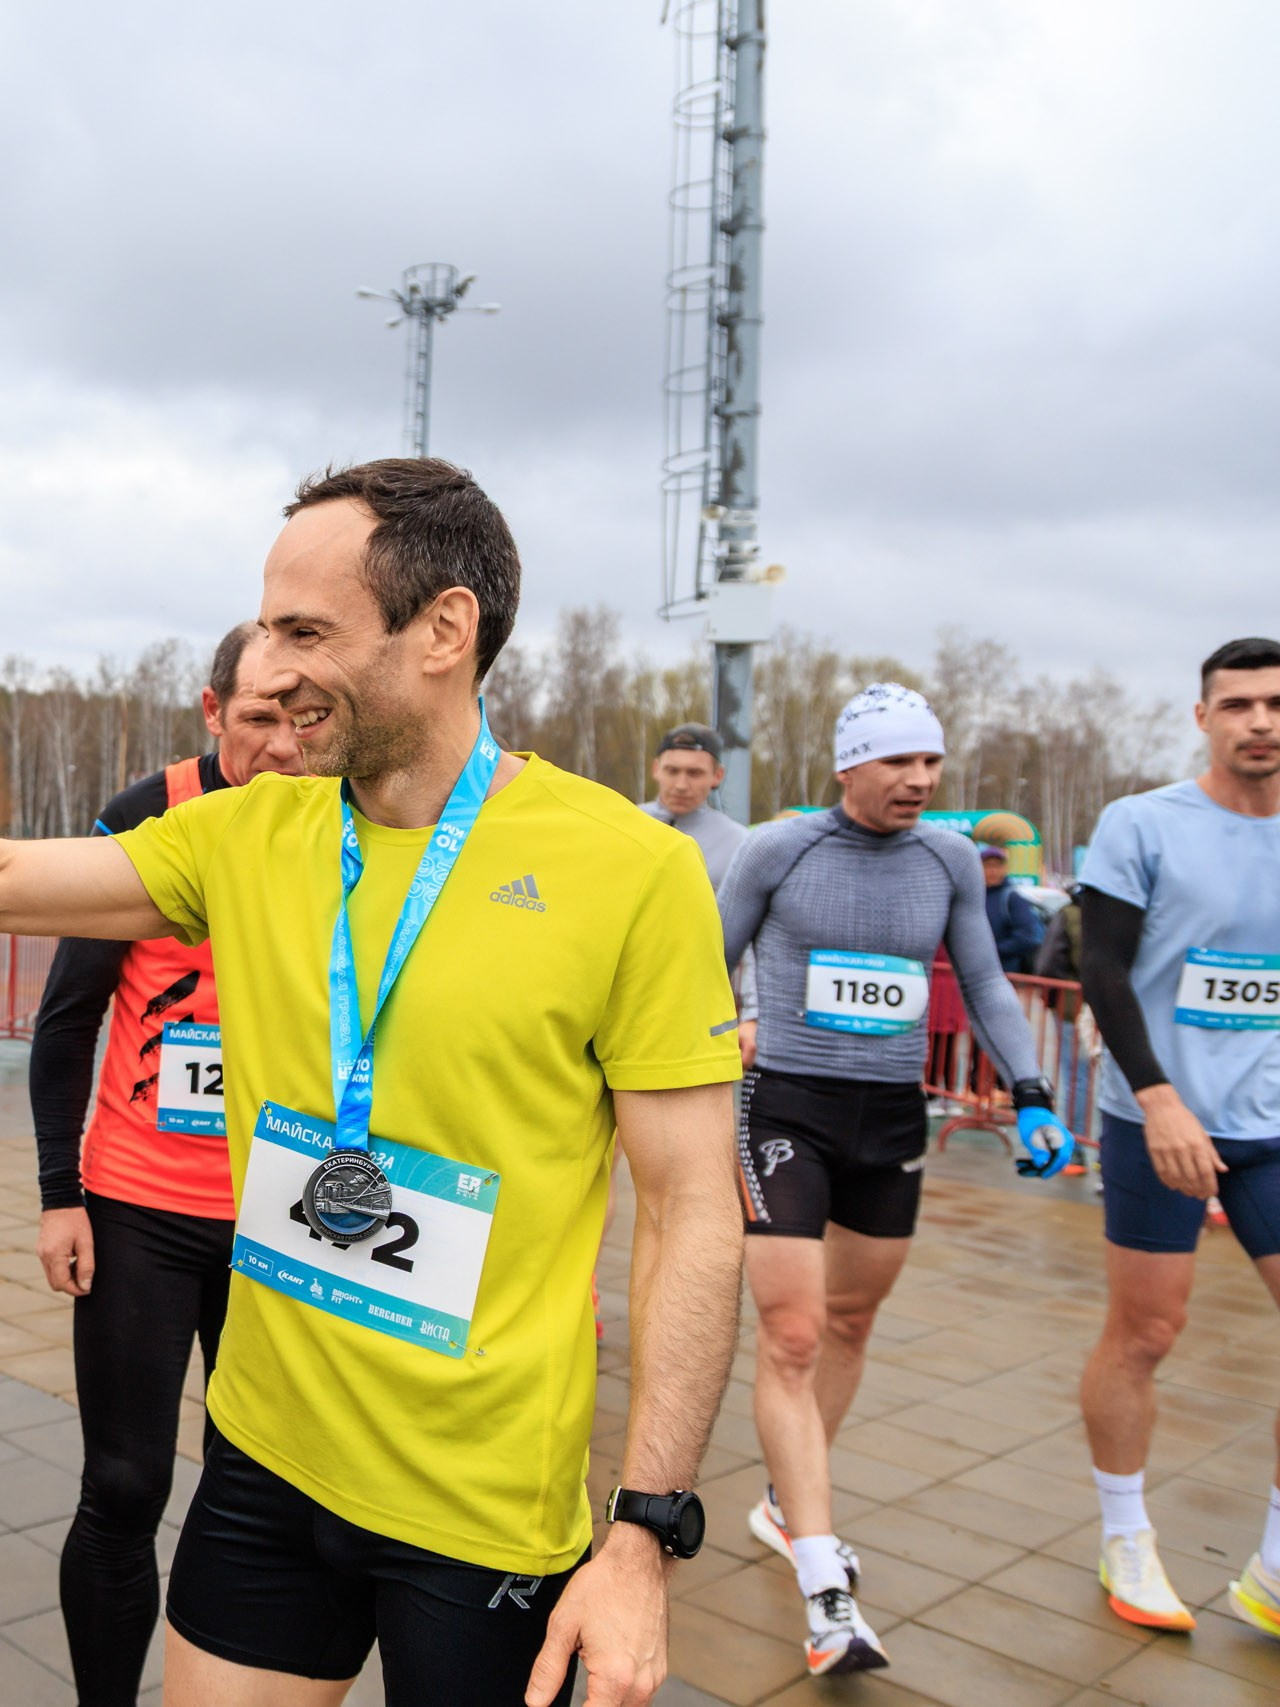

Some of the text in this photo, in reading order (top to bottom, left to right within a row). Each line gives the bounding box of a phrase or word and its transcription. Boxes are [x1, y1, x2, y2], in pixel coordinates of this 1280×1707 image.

[436, 834, 459, 853] 10
[489, 890, 547, 913] adidas
[832, 979, 904, 1007] 1180
[1204, 978, 1280, 1003] 1305
[337, 993, 352, 1048] ГРОЗА
[266, 1115, 335, 1150] МАЙСКА
[323, 1156, 375, 1172] ЕКАТЕРИНБУРГ
[248, 1254, 257, 1265] 10
[331, 1295, 342, 1304] FIT
[332, 1288, 360, 1304] BRIGHT
[419, 1320, 450, 1341] ВИСТА
